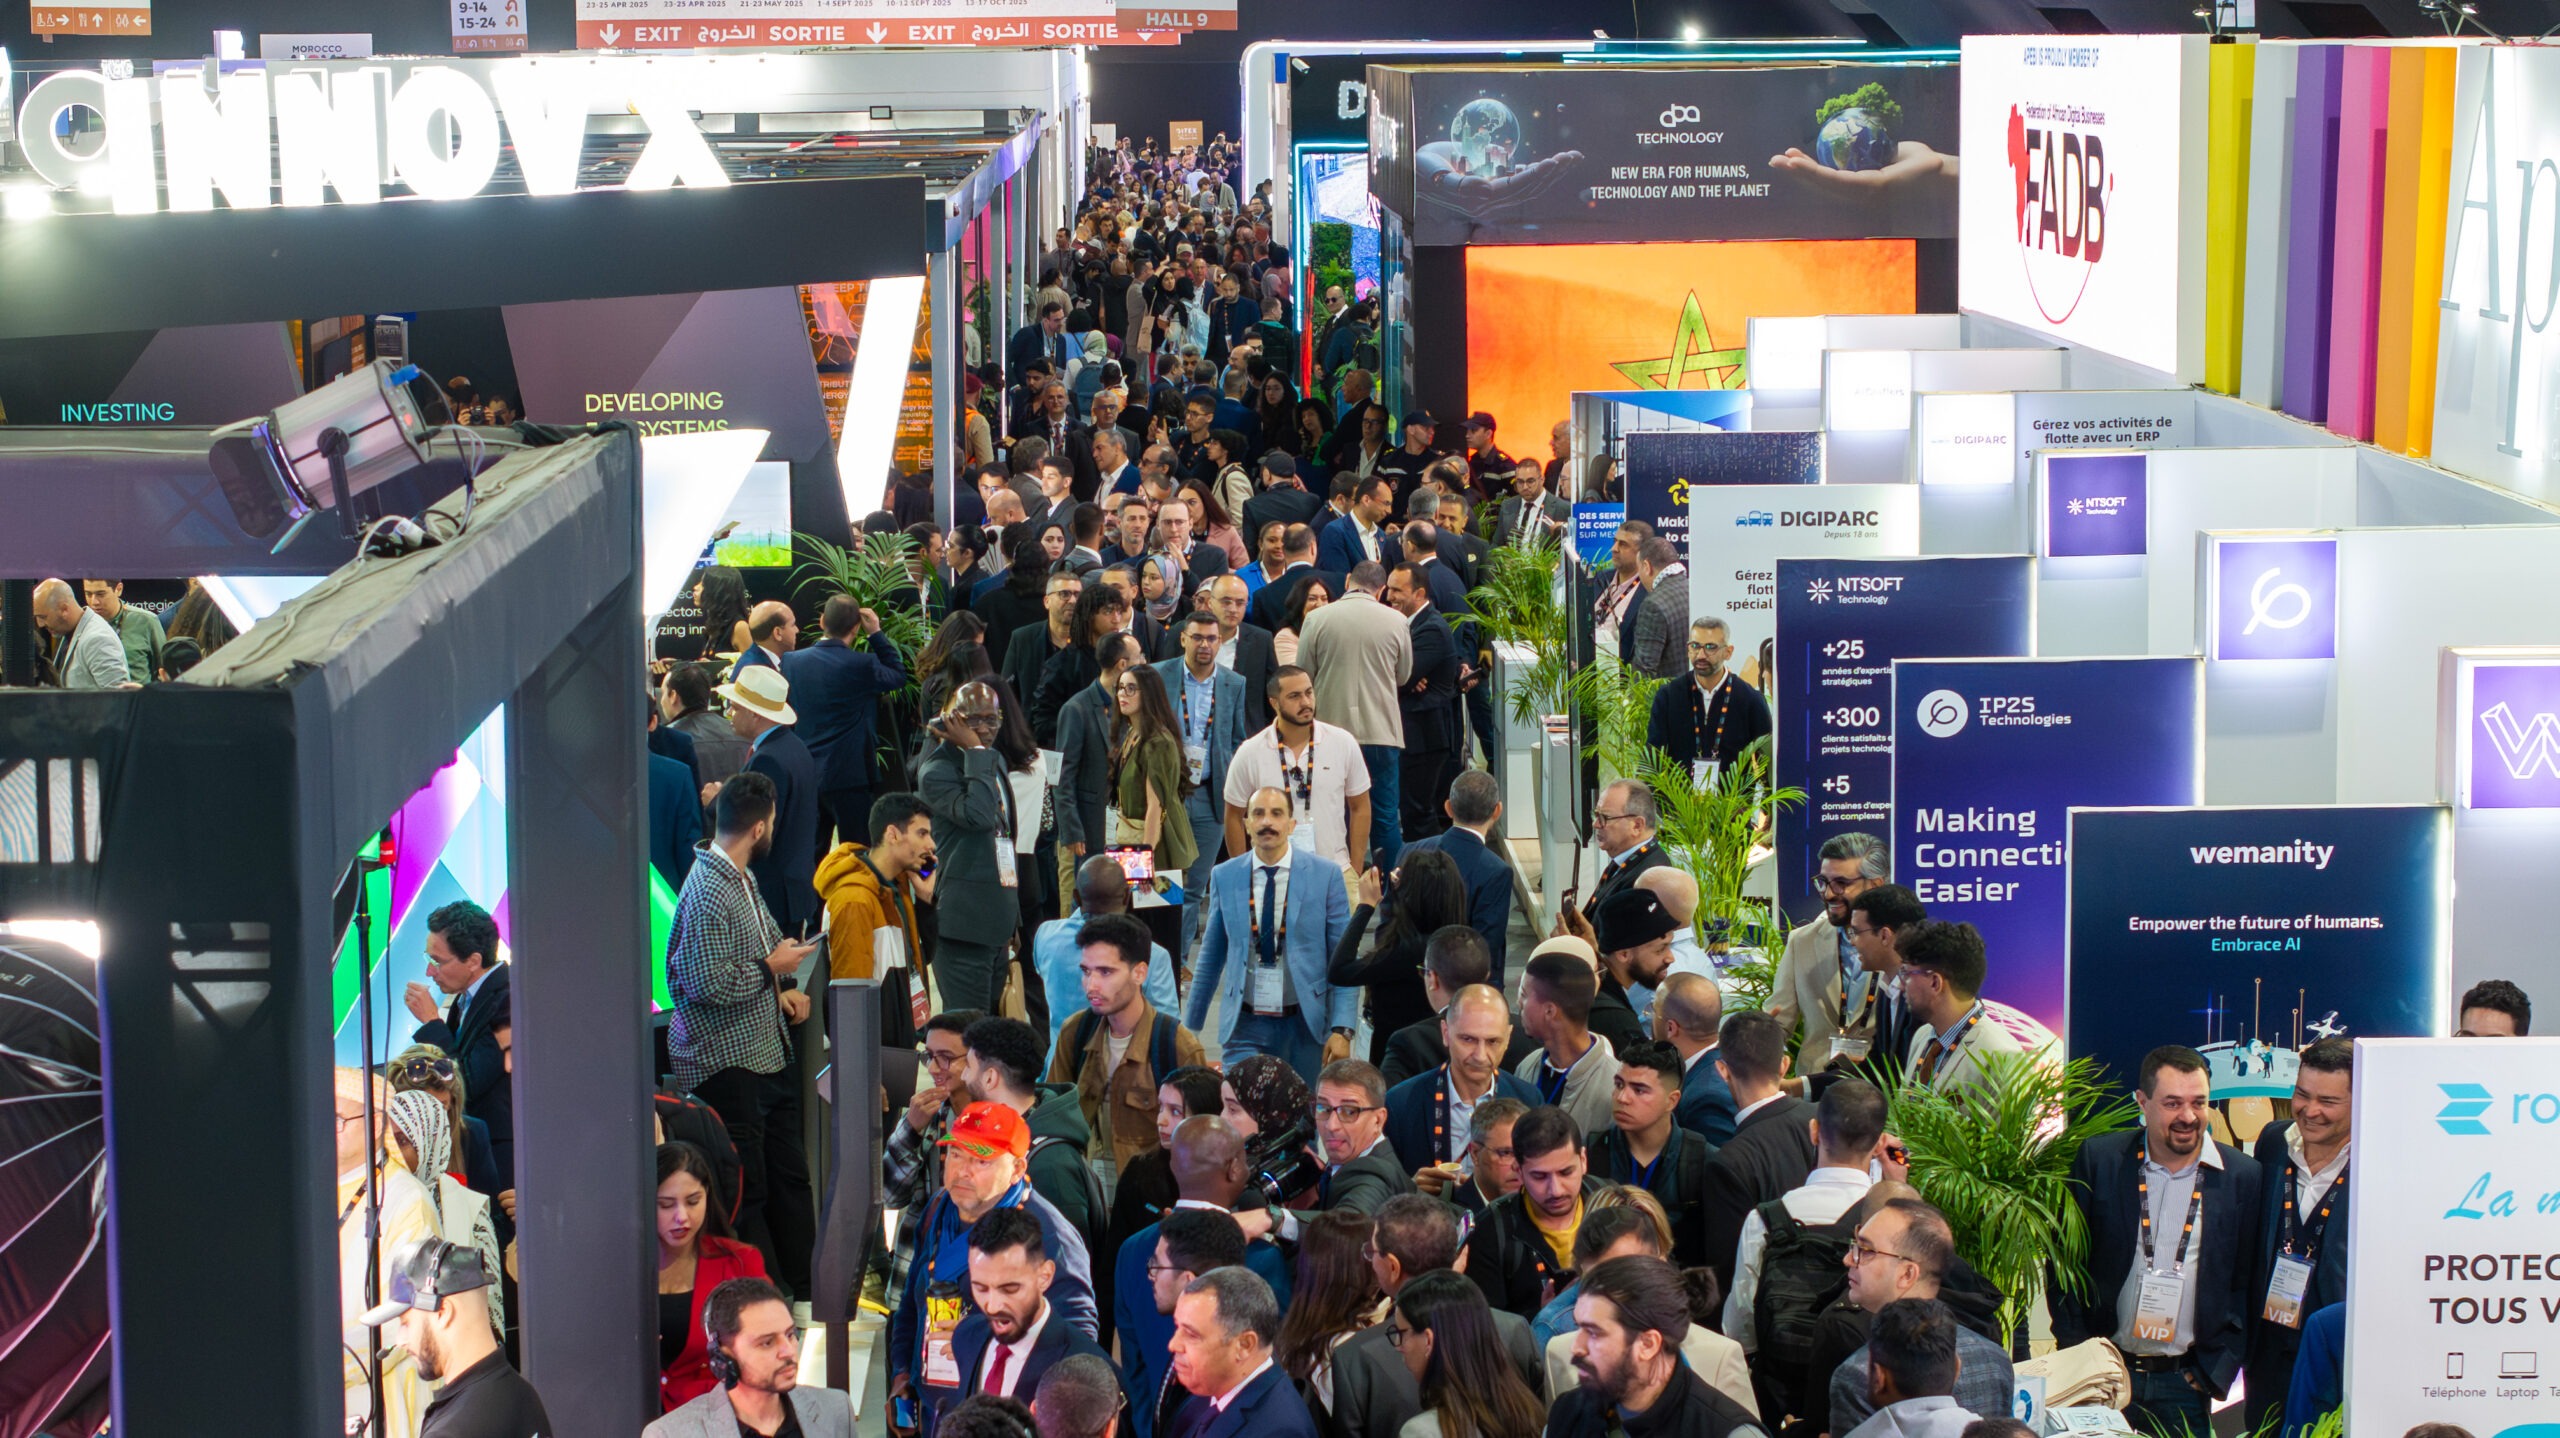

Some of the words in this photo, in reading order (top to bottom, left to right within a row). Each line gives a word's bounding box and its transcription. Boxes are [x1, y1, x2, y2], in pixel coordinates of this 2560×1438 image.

[459, 2, 488, 13] 9-14
[629, 0, 648, 8] 2025
[459, 17, 496, 29] 15-24
[1146, 12, 1193, 26] HALL
[1197, 12, 1208, 27] 9
[634, 26, 682, 42] EXIT
[698, 25, 756, 42] الخروج
[768, 26, 845, 42] SORTIE
[908, 25, 956, 40] EXIT
[971, 23, 1029, 40] الخروج
[1042, 23, 1118, 39] SORTIE
[292, 45, 342, 53] MOROCCO
[2068, 48, 2090, 67] MEMBER
[1636, 132, 1724, 144] TECHNOLOGY
[1611, 166, 1638, 180] NEW
[1642, 166, 1666, 179] ERA
[1668, 166, 1692, 179] FOR
[1694, 165, 1750, 180] HUMANS,
[1590, 186, 1668, 199] TECHNOLOGY
[1670, 185, 1696, 198] AND
[1698, 184, 1721, 198] THE
[1724, 184, 1770, 197] PLANET
[2026, 128, 2105, 264] FADB
[585, 392, 724, 413] DEVELOPING
[62, 402, 175, 422] INVESTING
[2033, 418, 2070, 430] Gérez
[2074, 420, 2095, 430] vos
[2100, 417, 2152, 428] activités
[2156, 416, 2172, 428] de
[1954, 435, 2008, 445] DIGIPARC
[2044, 432, 2078, 444] flotte
[2082, 434, 2112, 444] avec
[2116, 432, 2132, 442] un
[2136, 431, 2160, 442] ERP
[2086, 496, 2127, 508] NTSOFT
[1579, 512, 1598, 520] DES
[1658, 516, 1689, 528] Maki
[1780, 510, 1879, 527] DIGIPARC
[1579, 522, 1591, 530] DE
[1579, 531, 1597, 539] SUR
[1665, 532, 1679, 542] to
[1824, 530, 1851, 539] Depuis
[1852, 530, 1863, 538] 18
[1735, 570, 1772, 581] Gérez
[1838, 576, 1904, 592] NTSOFT
[1726, 599, 1773, 612] spécial
[1837, 594, 1889, 605] Technology
[664, 606, 703, 618] ectors
[1822, 640, 1864, 660] +25
[1822, 666, 1852, 676] années
[1822, 678, 1872, 688] stratégiques
[1979, 696, 2035, 714] IP2S
[1822, 706, 1880, 727] +300
[1980, 714, 2072, 728] Technologies
[1822, 734, 1850, 743] clients
[1850, 734, 1886, 742] satisfaits
[1822, 746, 1850, 755] projets
[1822, 774, 1850, 794] +5
[1822, 802, 1862, 810] domaines
[1822, 813, 1840, 822] plus
[1840, 812, 1885, 822] complexes
[1915, 806, 2036, 837] Making
[1915, 840, 2065, 868] Connecti
[2190, 838, 2334, 870] wemanity
[1914, 876, 2020, 903] Easier
[2129, 916, 2207, 934] Empower
[2208, 916, 2236, 930] the
[2239, 915, 2291, 930] future
[2294, 914, 2312, 929] of
[2314, 914, 2384, 929] humans.
[2211, 937, 2282, 952] Embrace
[2284, 937, 2300, 951] AI
[2442, 1171, 2519, 1220] La
[2268, 1306, 2296, 1325] VIP
[2429, 1296, 2528, 1325] TOUS
[2139, 1324, 2170, 1340] VIP
[2422, 1386, 2487, 1400] Téléphone
[2496, 1386, 2540, 1400] Laptop
